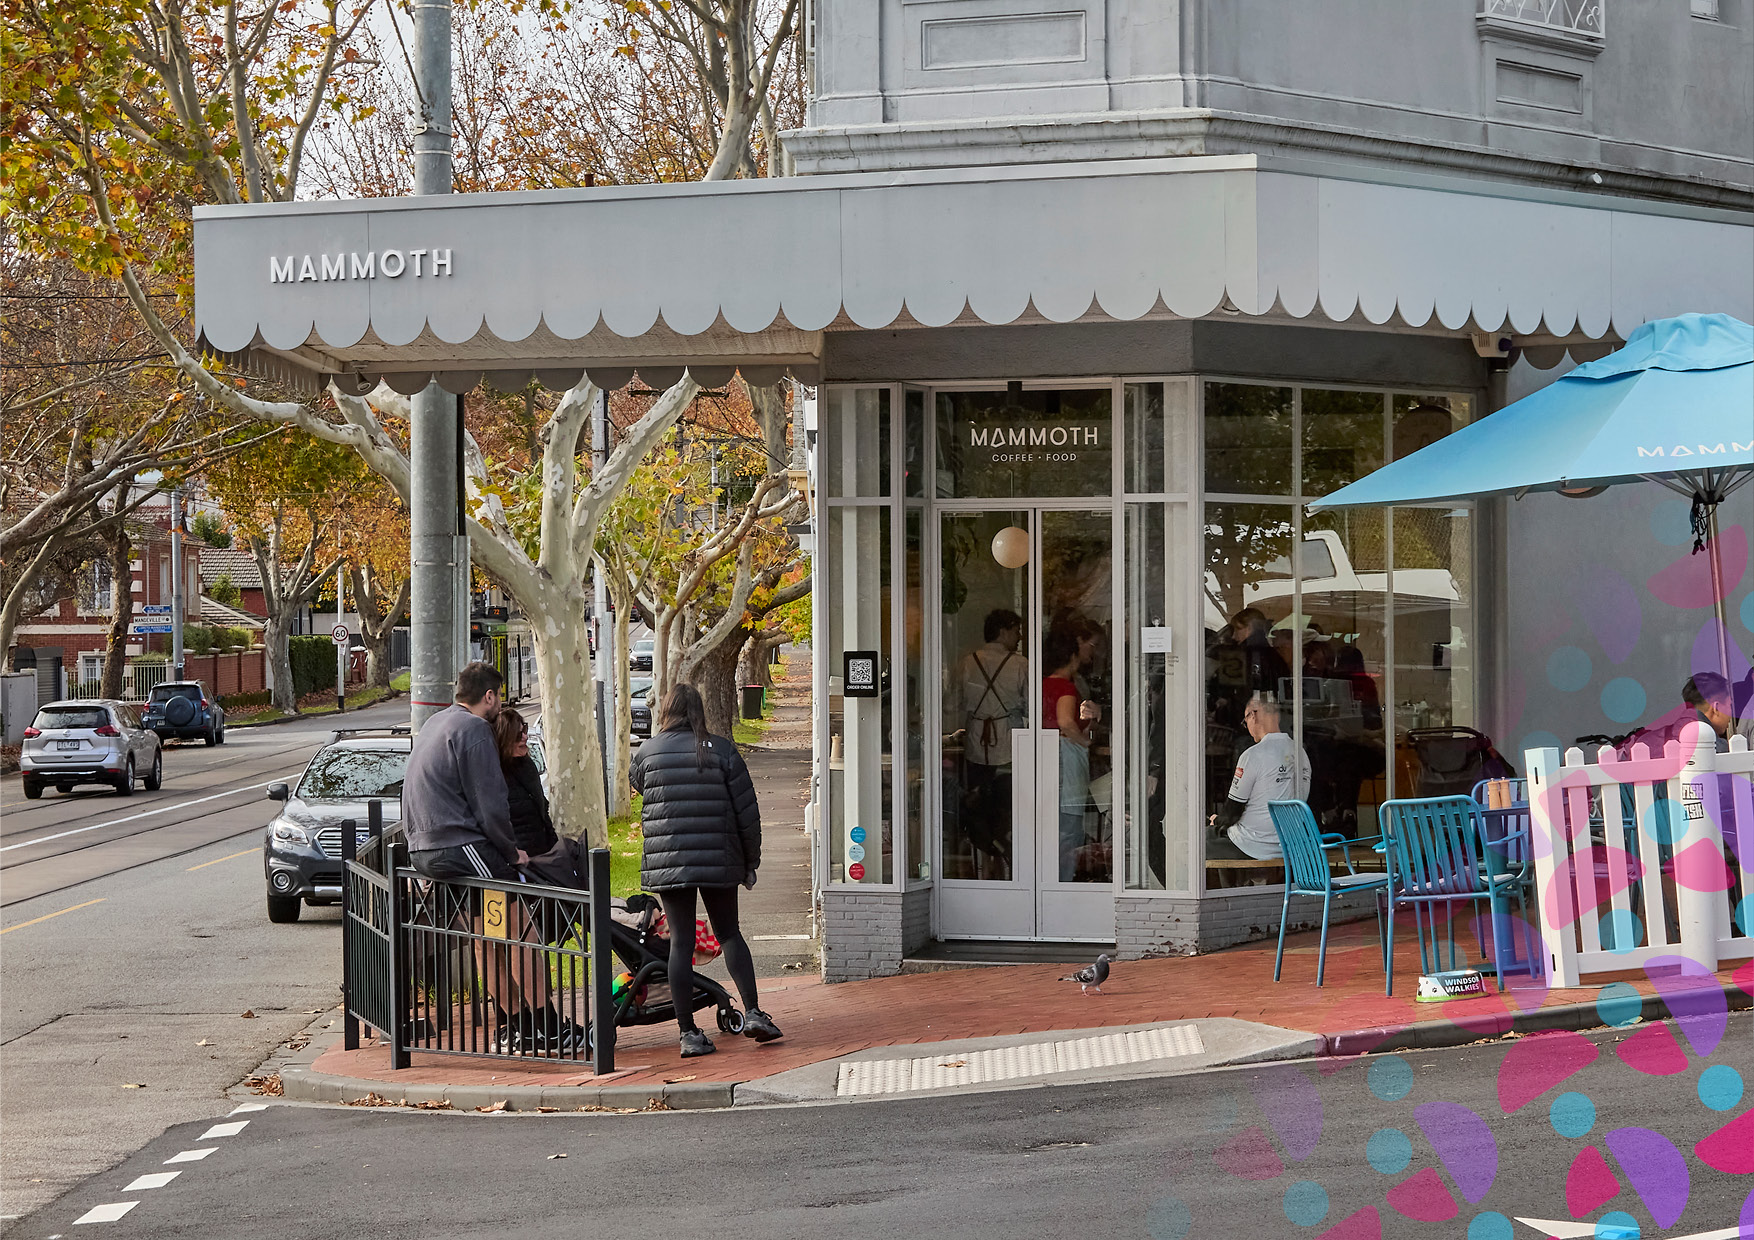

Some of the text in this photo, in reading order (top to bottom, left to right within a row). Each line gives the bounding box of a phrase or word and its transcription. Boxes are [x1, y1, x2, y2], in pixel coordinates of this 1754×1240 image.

[270, 249, 453, 284] MAMMOTH
[970, 426, 1099, 448] MAMMOTH
[991, 453, 1078, 463] COFFEE FOOD
[335, 629, 346, 638] 60
[487, 899, 503, 927] S
[1444, 983, 1480, 994] WALKIES
